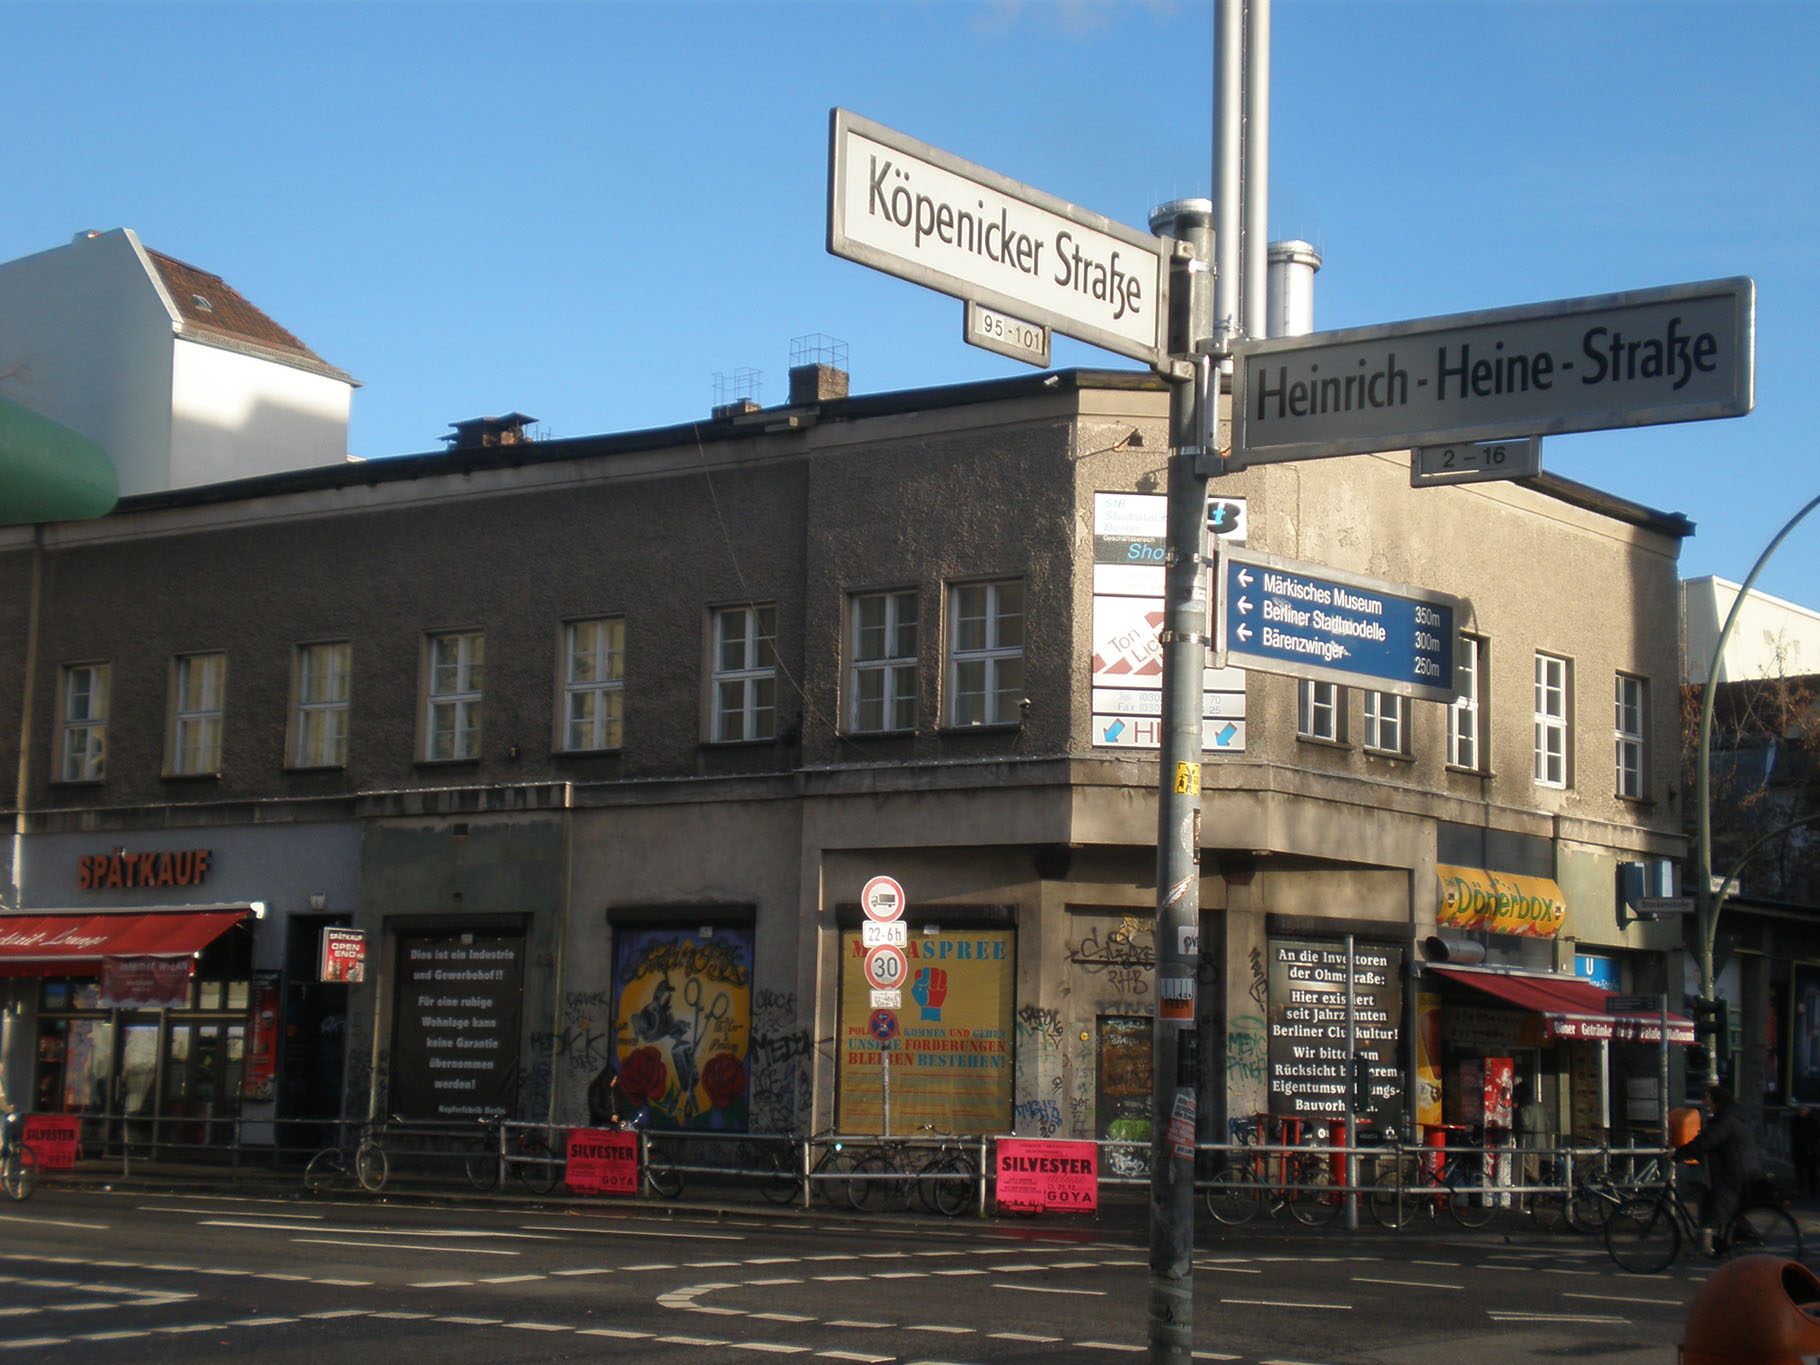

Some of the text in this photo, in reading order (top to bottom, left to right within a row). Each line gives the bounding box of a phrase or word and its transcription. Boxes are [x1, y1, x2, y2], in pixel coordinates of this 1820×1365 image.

[868, 153, 1142, 320] Köpenicker Straße
[1263, 573, 1441, 627] Märkisches Museum 350m
[1263, 599, 1441, 652] Berliner Stadtmodelle 300m
[1106, 628, 1141, 653] Ton
[1262, 627, 1440, 677] Bärenzwinger 250m
[1117, 703, 1136, 712] Fax
[77, 847, 213, 890] SPÄTKAUF
[331, 943, 361, 951] OPEN
[334, 950, 356, 958] END
[852, 940, 1008, 960] MASPREE
[1278, 949, 1296, 961] An
[1299, 949, 1319, 962] die
[874, 956, 898, 978] 30
[1289, 966, 1311, 979] der
[1291, 990, 1376, 1005] Hier exisiert
[421, 1016, 497, 1030] Wohnlage kann
[1286, 1008, 1388, 1024] seit Jahrzhnten
[903, 1027, 947, 1038] KOMMEN
[949, 1027, 970, 1038] UND
[972, 1027, 1007, 1039] GEHEN
[1272, 1024, 1324, 1037] Berliner
[1554, 1020, 1577, 1035] Döner
[1581, 1022, 1613, 1038] Getränke
[426, 1037, 499, 1049] keine Garantie
[904, 1039, 1006, 1052] FORDERUNGEN
[1293, 1046, 1316, 1059] Wir
[917, 1053, 1006, 1069] BESTEHEN!
[1274, 1064, 1337, 1077] Rücksicht
[1340, 1064, 1358, 1077] bi
[571, 1143, 634, 1161] SILVESTER
[1001, 1156, 1093, 1175] SILVESTER
[601, 1175, 635, 1186] GOYA
[1047, 1190, 1093, 1203] GOYA
